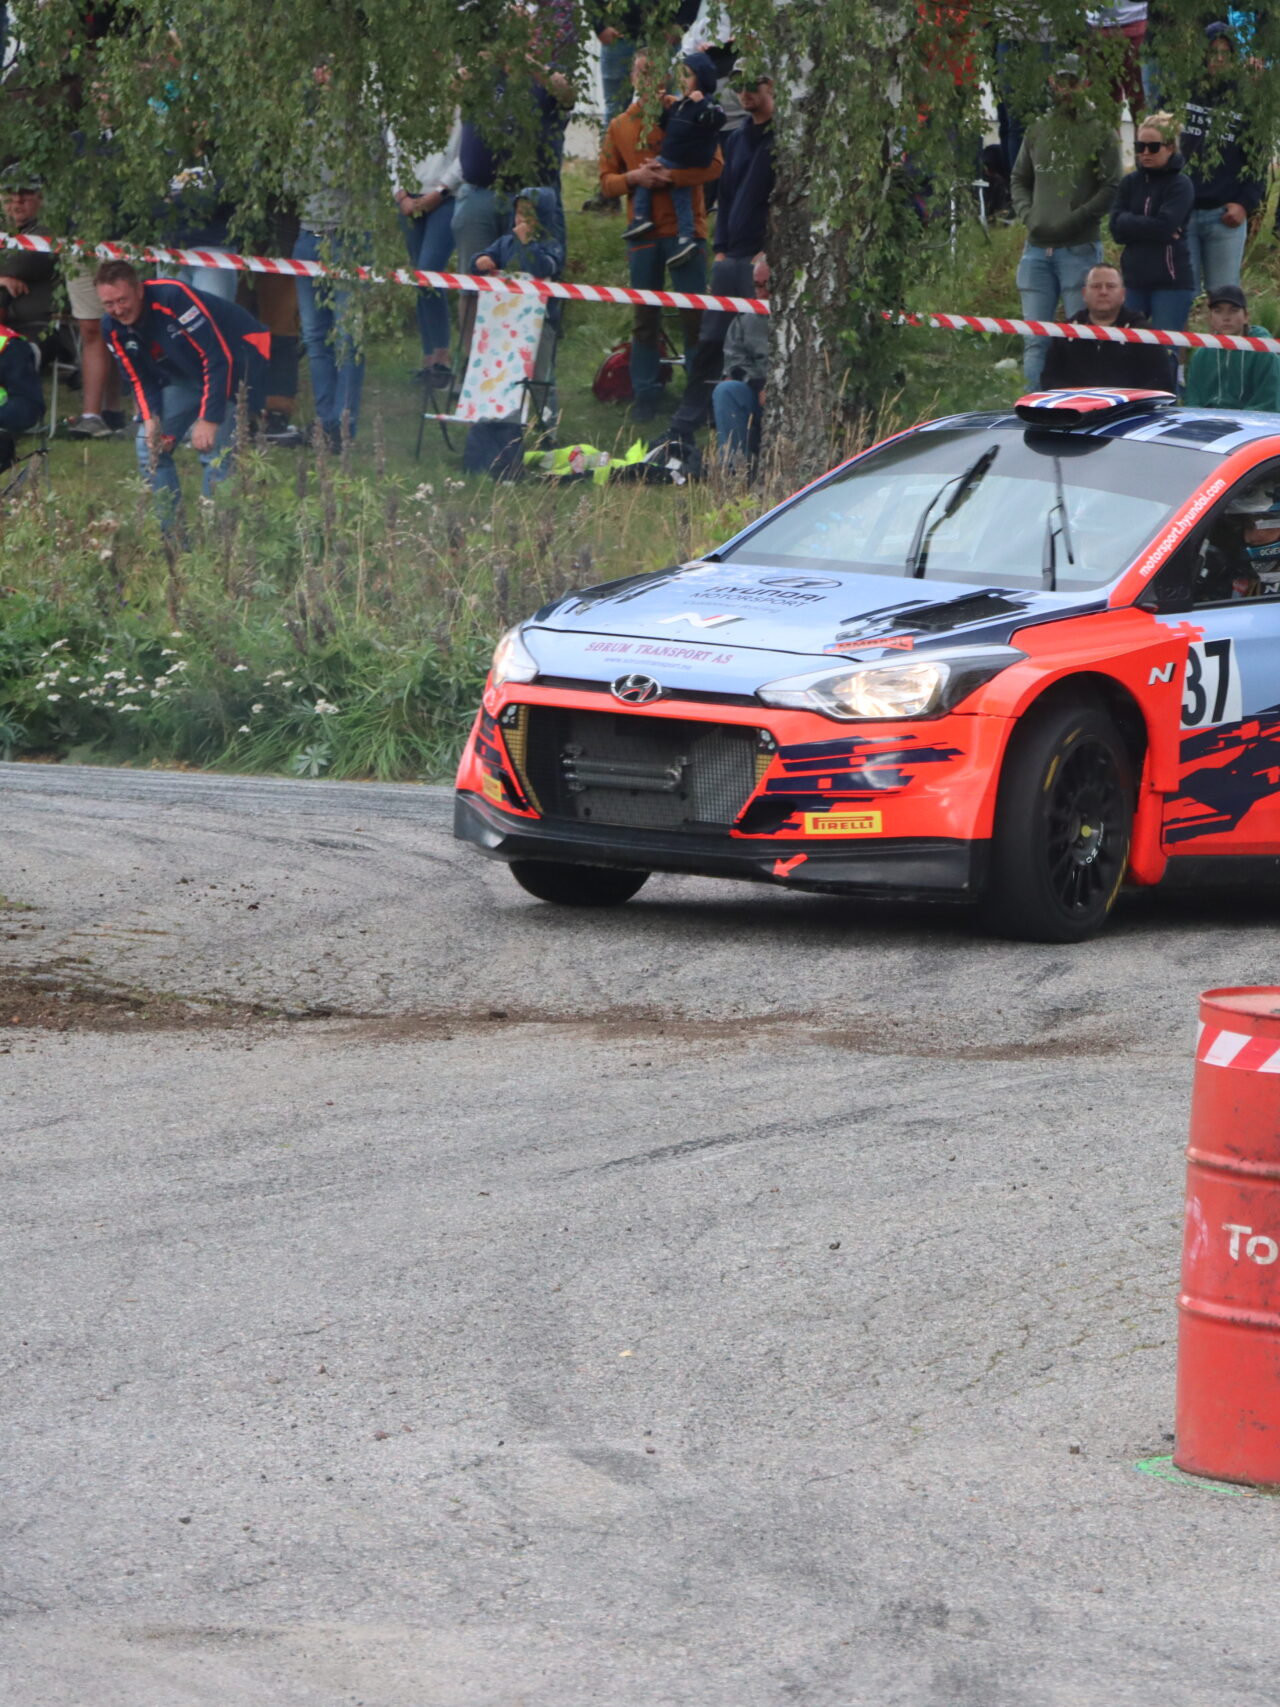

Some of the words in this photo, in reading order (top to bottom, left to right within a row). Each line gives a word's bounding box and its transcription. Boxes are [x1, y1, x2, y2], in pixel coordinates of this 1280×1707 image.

[1138, 478, 1227, 577] motorsport.hyundai.com
[690, 592, 809, 608] MOTORSPORT
[704, 586, 828, 602] HYUNDAI
[584, 641, 634, 653] SØRUM
[637, 644, 714, 662] TRANSPORT
[712, 653, 734, 665] AS
[1181, 638, 1232, 727] 37
[812, 816, 875, 830] PIRELLI
